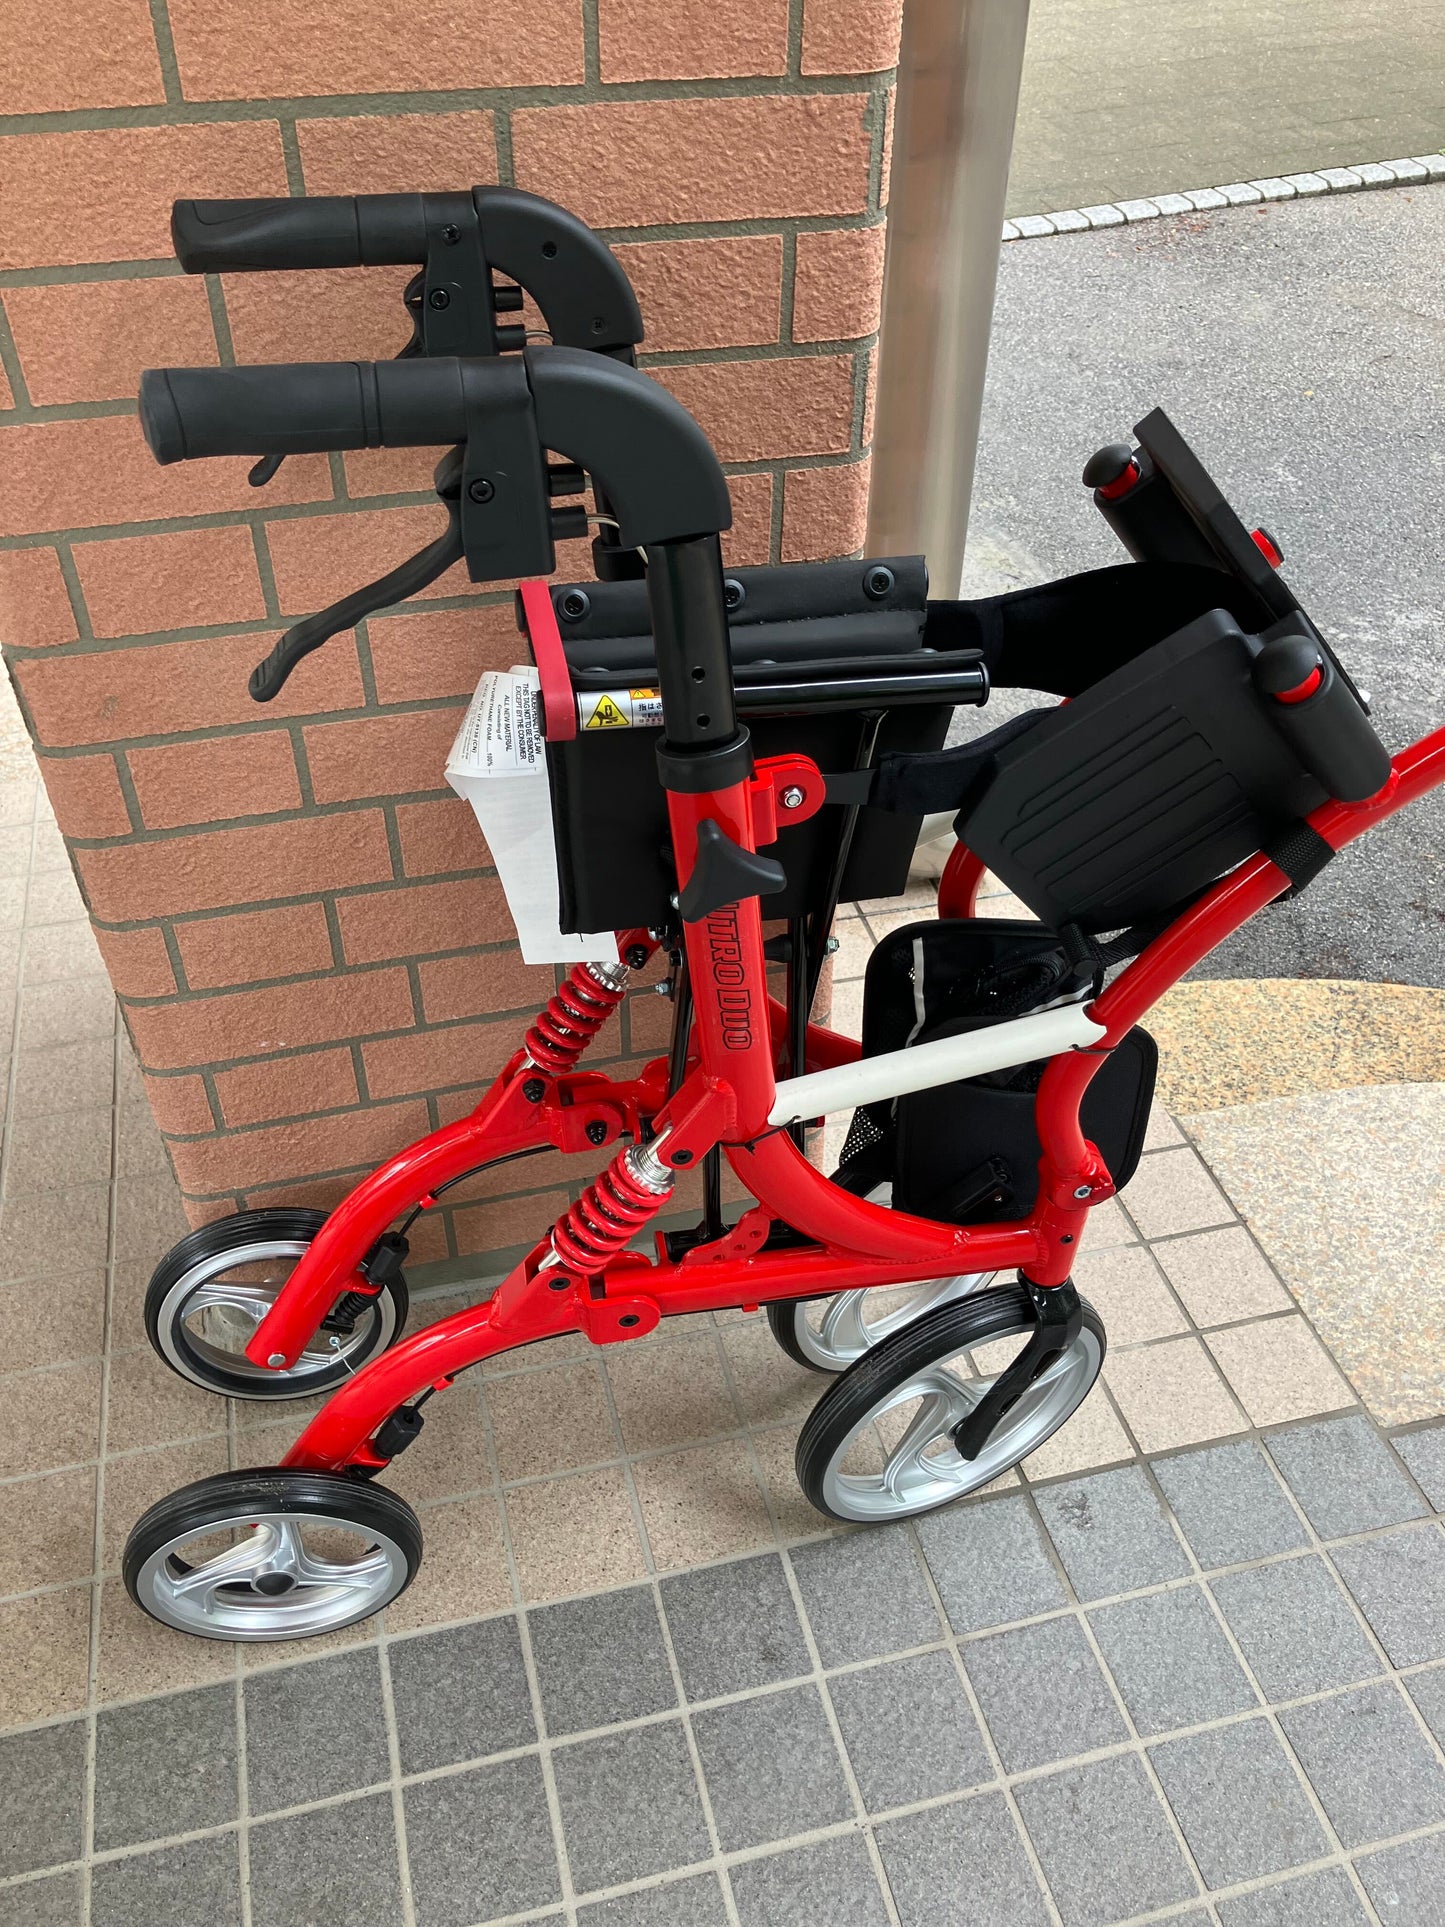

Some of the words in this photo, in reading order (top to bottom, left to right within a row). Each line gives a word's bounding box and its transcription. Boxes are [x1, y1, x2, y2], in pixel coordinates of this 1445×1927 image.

[516, 709, 522, 718] BY
[518, 730, 526, 760] CONSUMER
[526, 737, 535, 764] REMOVED
[706, 902, 744, 986] ITRO
